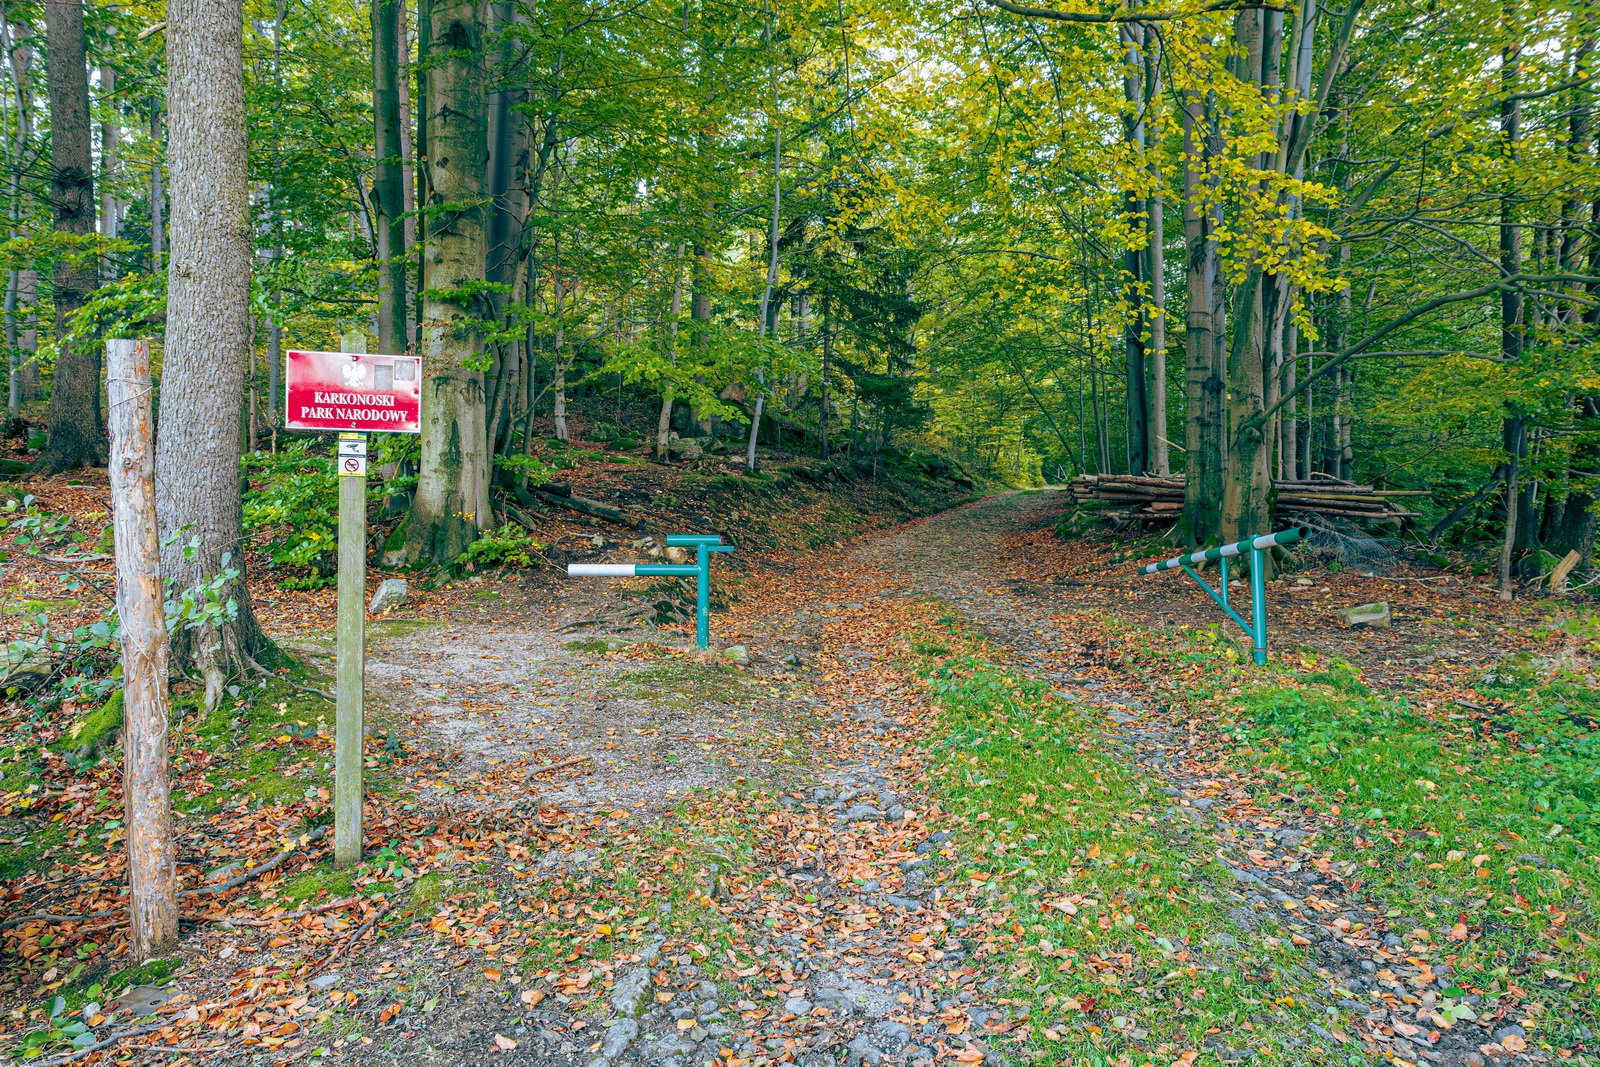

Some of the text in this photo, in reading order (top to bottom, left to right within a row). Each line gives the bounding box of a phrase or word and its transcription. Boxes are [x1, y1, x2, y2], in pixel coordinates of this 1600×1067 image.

[314, 392, 395, 406] KARKONOSKI
[301, 406, 408, 422] PARK NARODOWY
